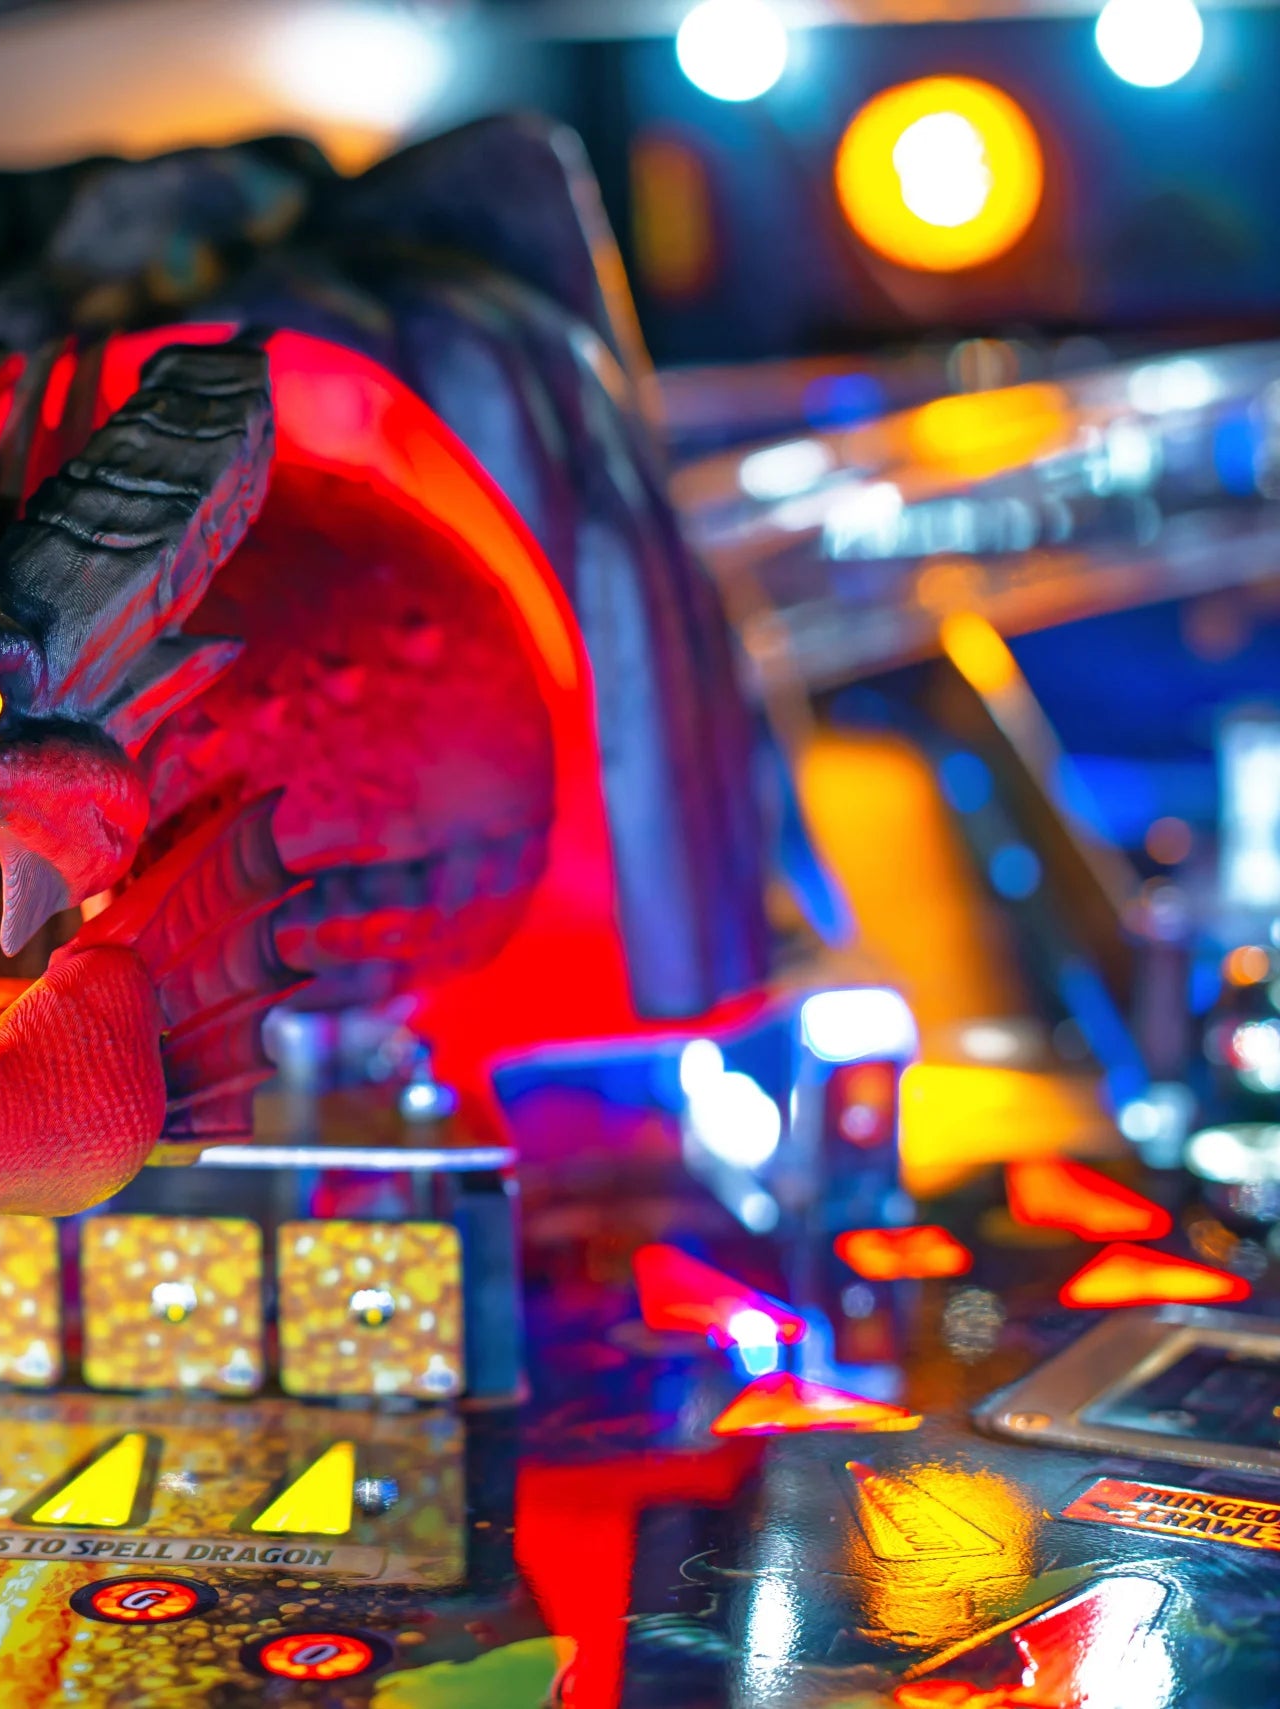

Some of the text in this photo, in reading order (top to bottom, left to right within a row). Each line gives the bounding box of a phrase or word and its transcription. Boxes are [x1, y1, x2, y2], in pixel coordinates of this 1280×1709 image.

[1134, 1491, 1280, 1524] DUNGEO
[1138, 1509, 1265, 1540] CRAWL
[20, 1536, 67, 1555] TO
[71, 1539, 173, 1560] SPELL
[183, 1543, 335, 1566] DRAGON
[121, 1588, 169, 1610] G
[292, 1643, 340, 1666] O
